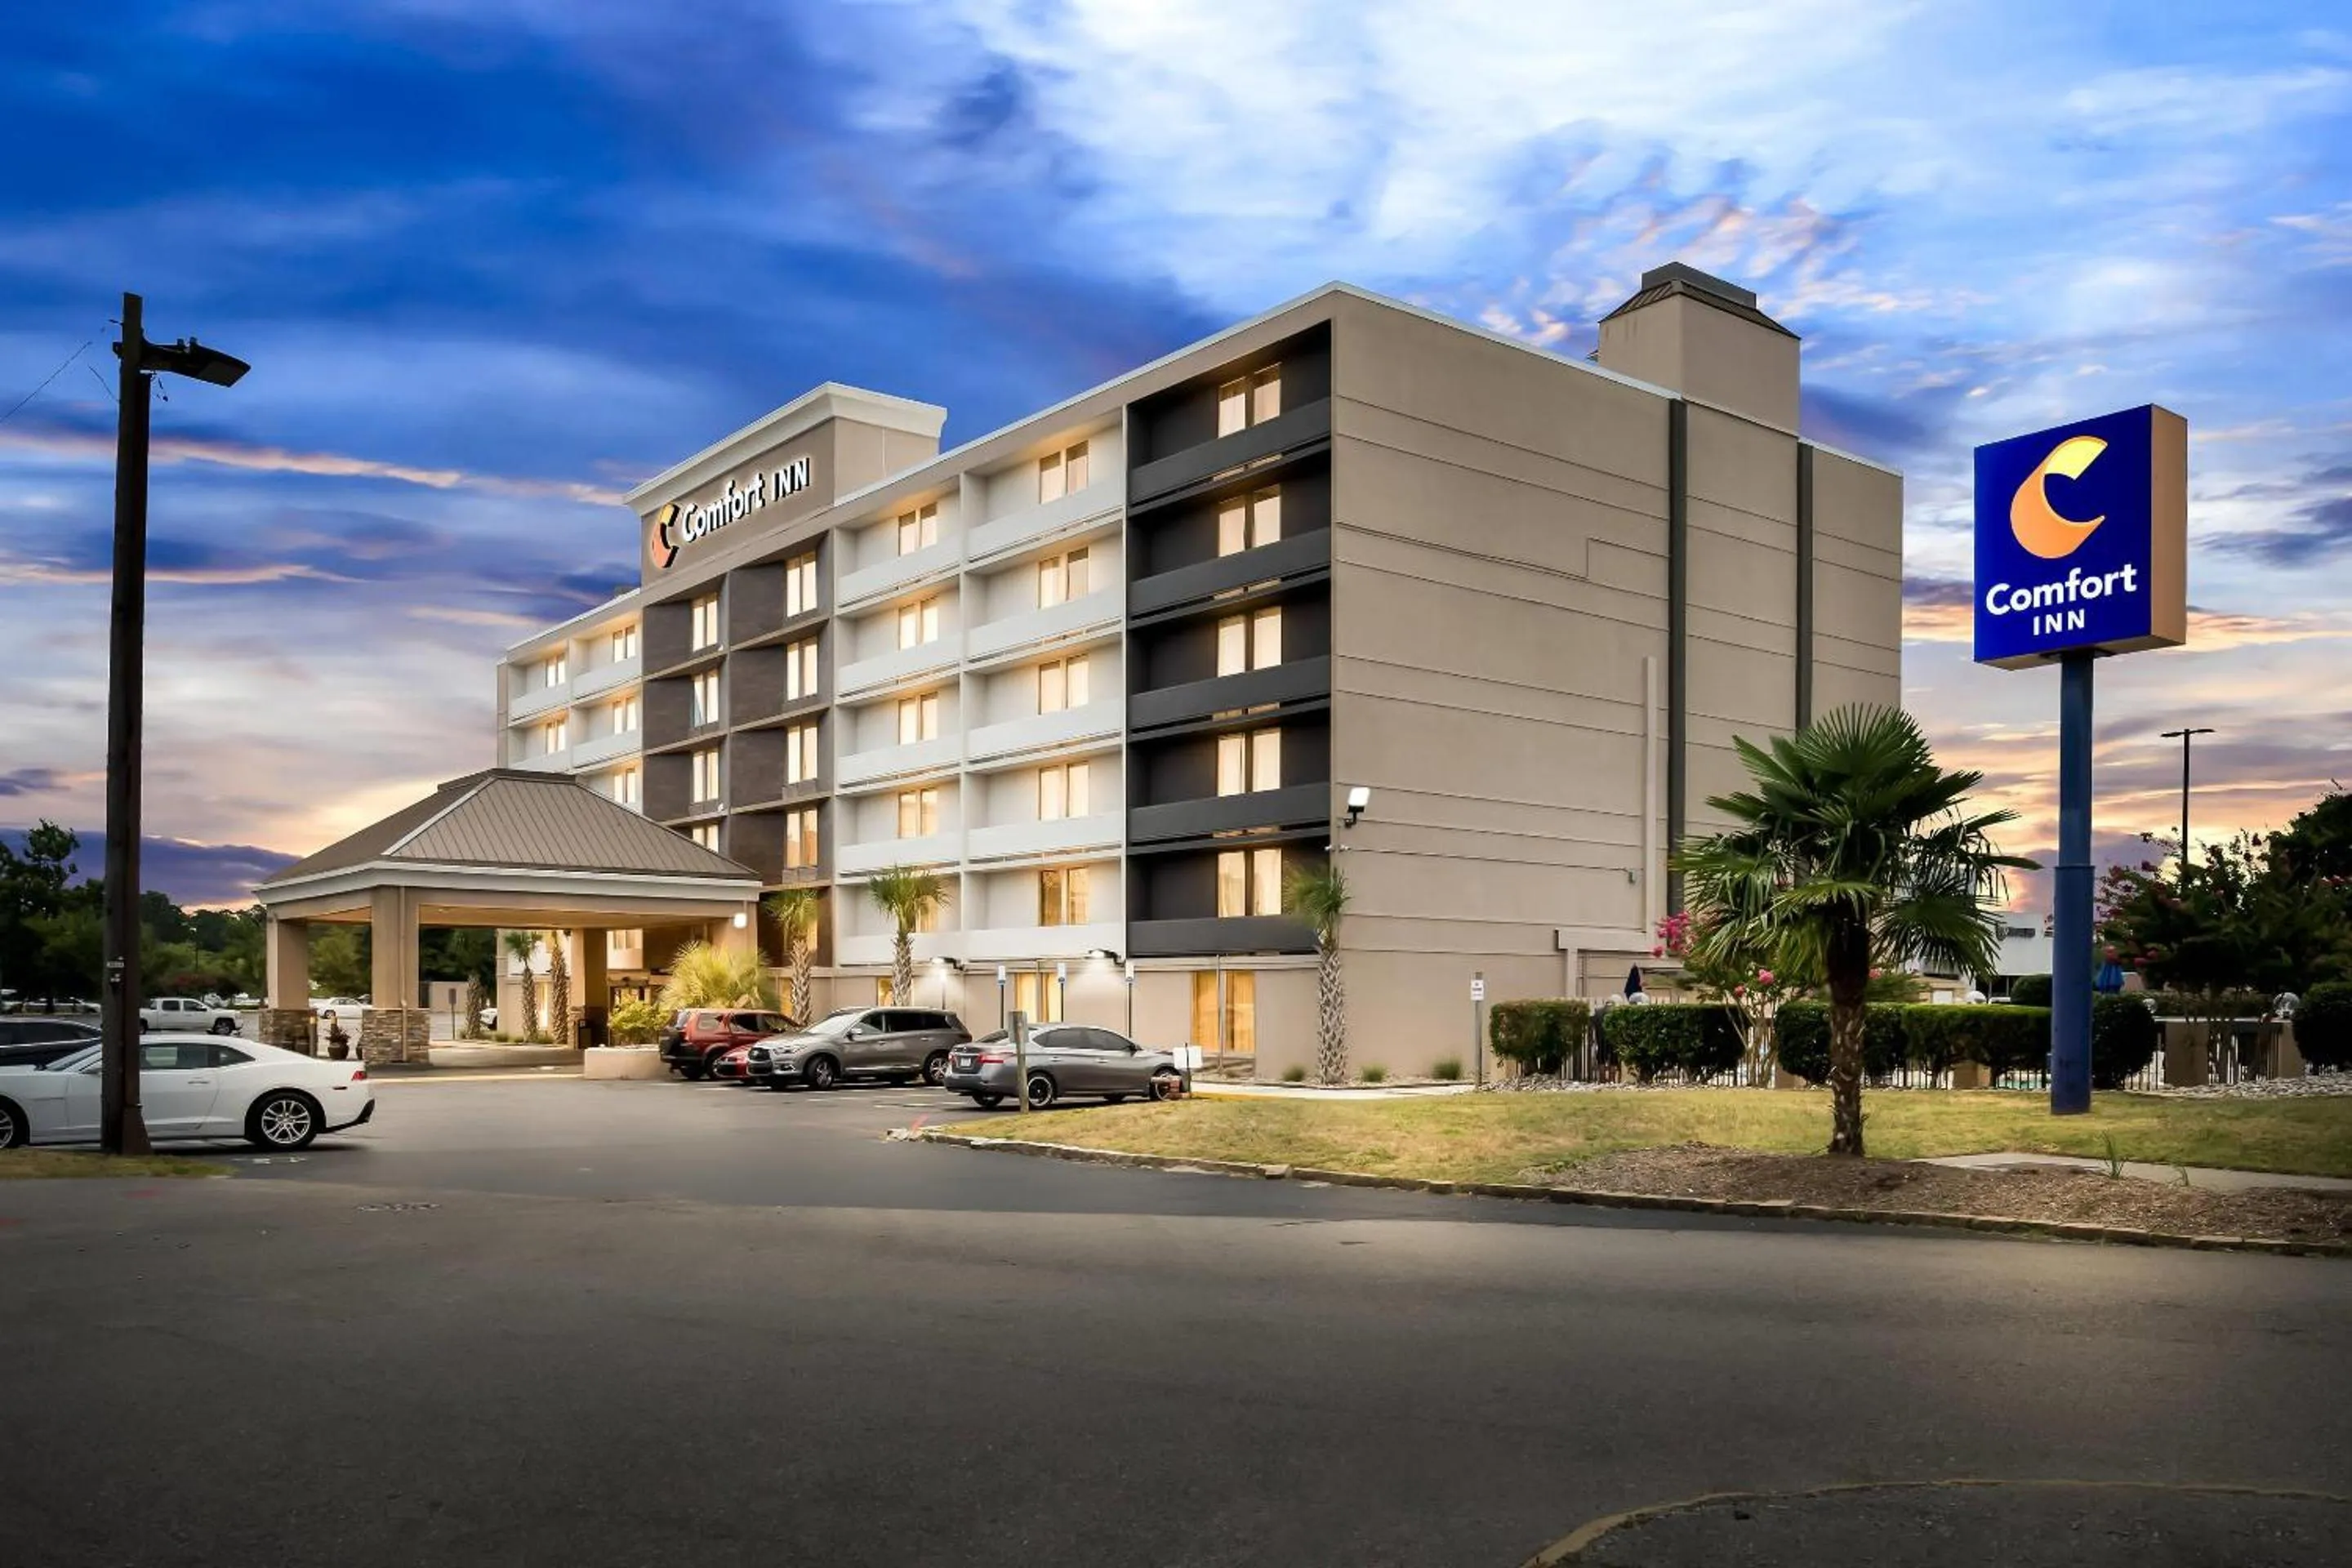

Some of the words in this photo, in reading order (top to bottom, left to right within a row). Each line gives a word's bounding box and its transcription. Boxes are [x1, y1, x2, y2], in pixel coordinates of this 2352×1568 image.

[683, 473, 765, 542] Comfort
[772, 457, 810, 501] INN
[1985, 564, 2137, 615] Comfort
[2033, 609, 2085, 635] INN
